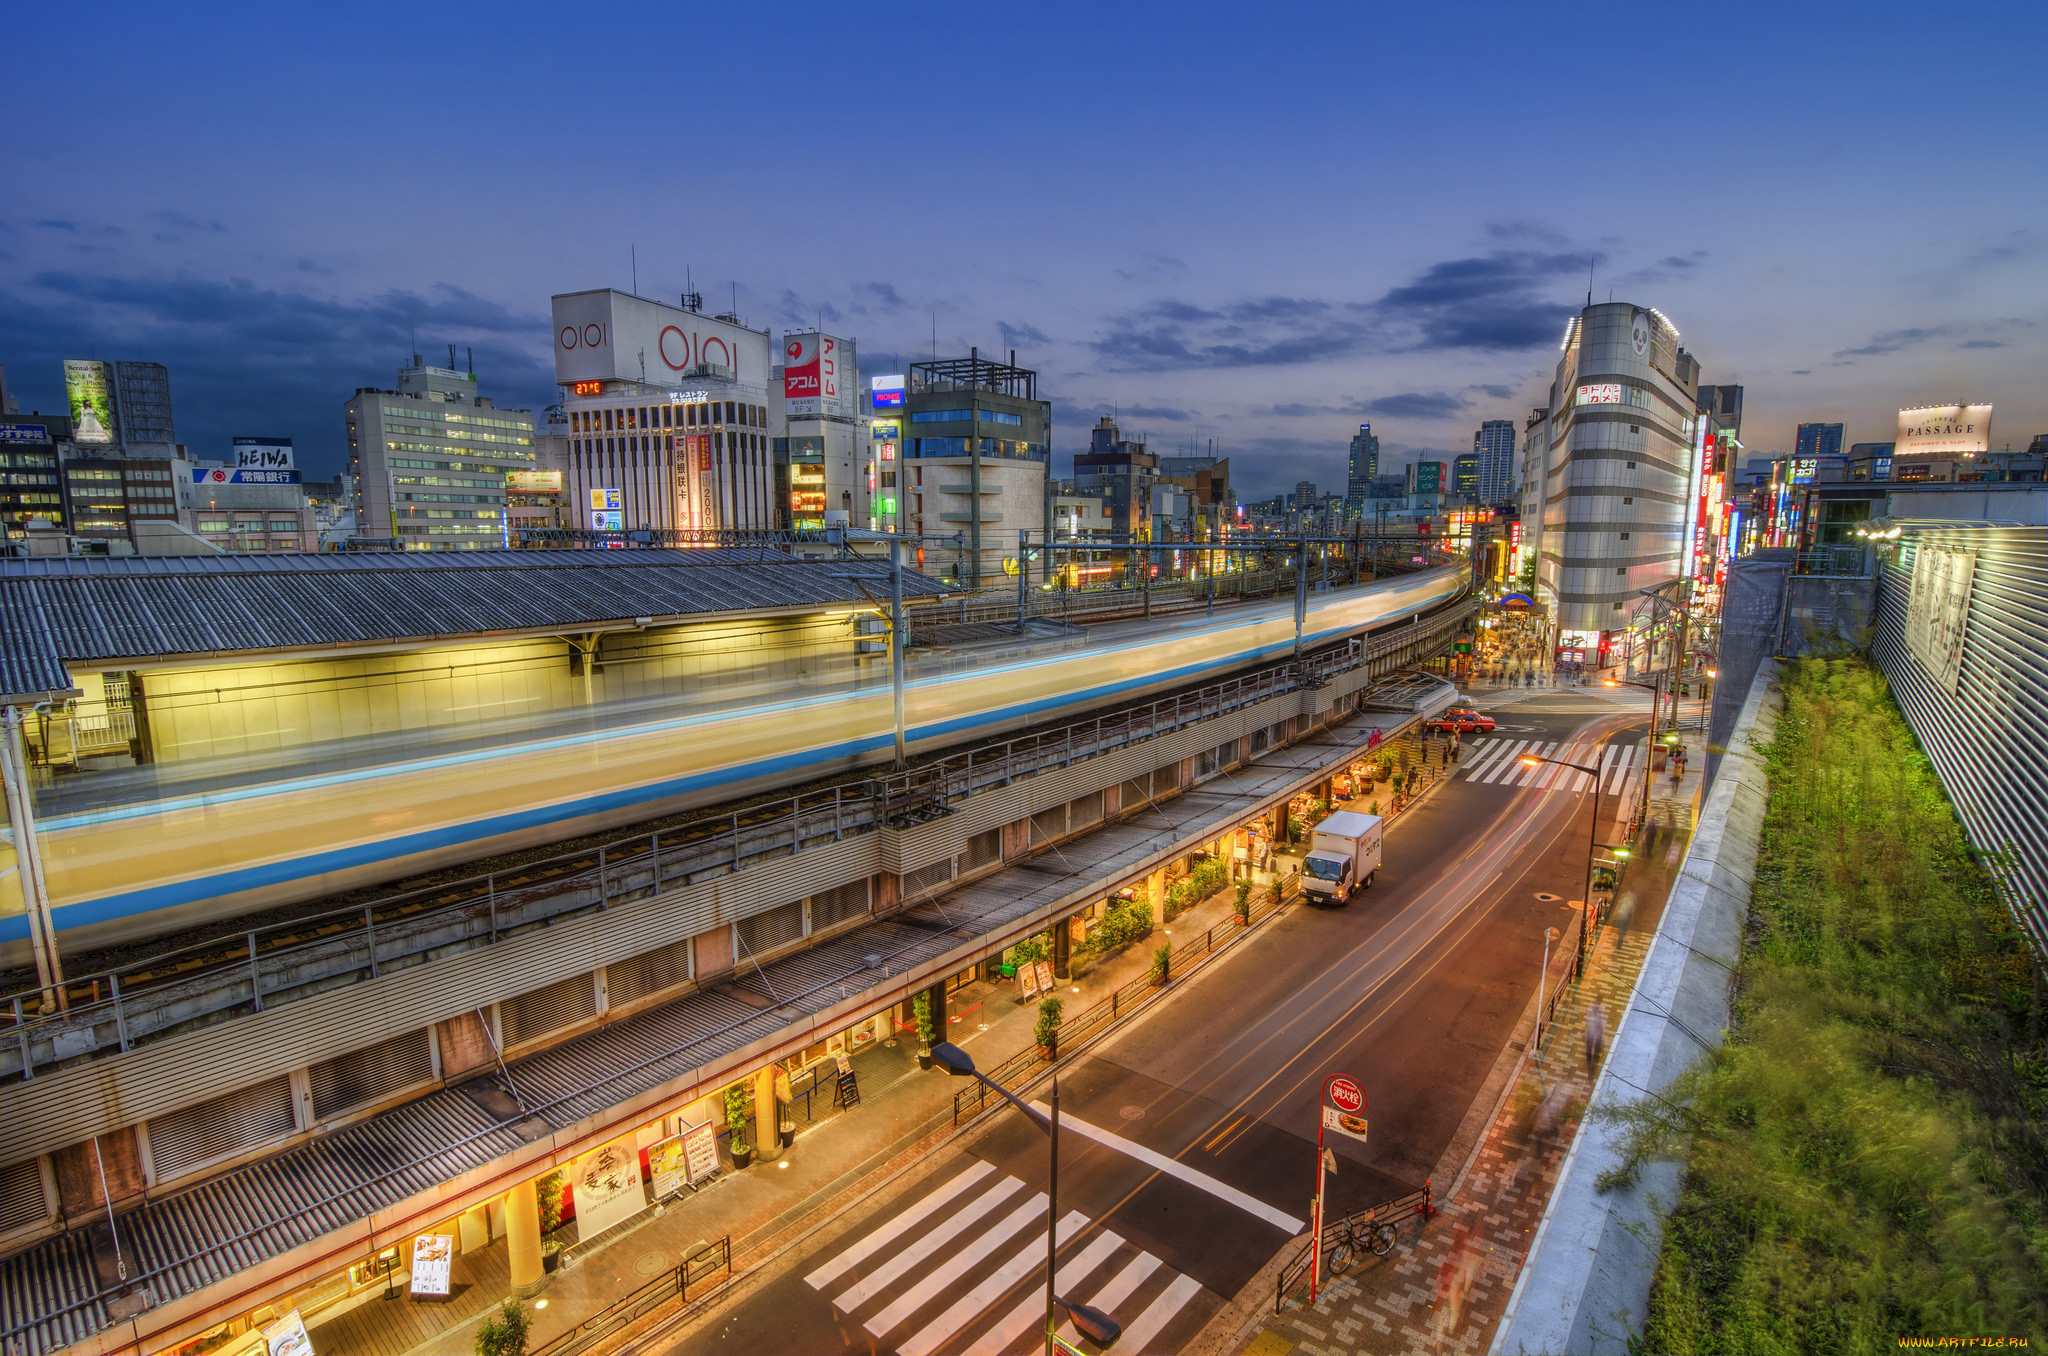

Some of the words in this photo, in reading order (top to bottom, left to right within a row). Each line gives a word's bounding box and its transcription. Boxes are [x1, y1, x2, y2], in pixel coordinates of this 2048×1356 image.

[822, 338, 836, 396] アコム
[788, 376, 819, 390] アコム
[1581, 385, 1620, 395] ヨドバシ
[1590, 395, 1619, 403] カメラ
[1907, 424, 1974, 437] PASSAGE
[238, 448, 288, 468] HEIWA
[240, 471, 290, 483] 常陽銀行
[1333, 1086, 1359, 1105] 消火栓
